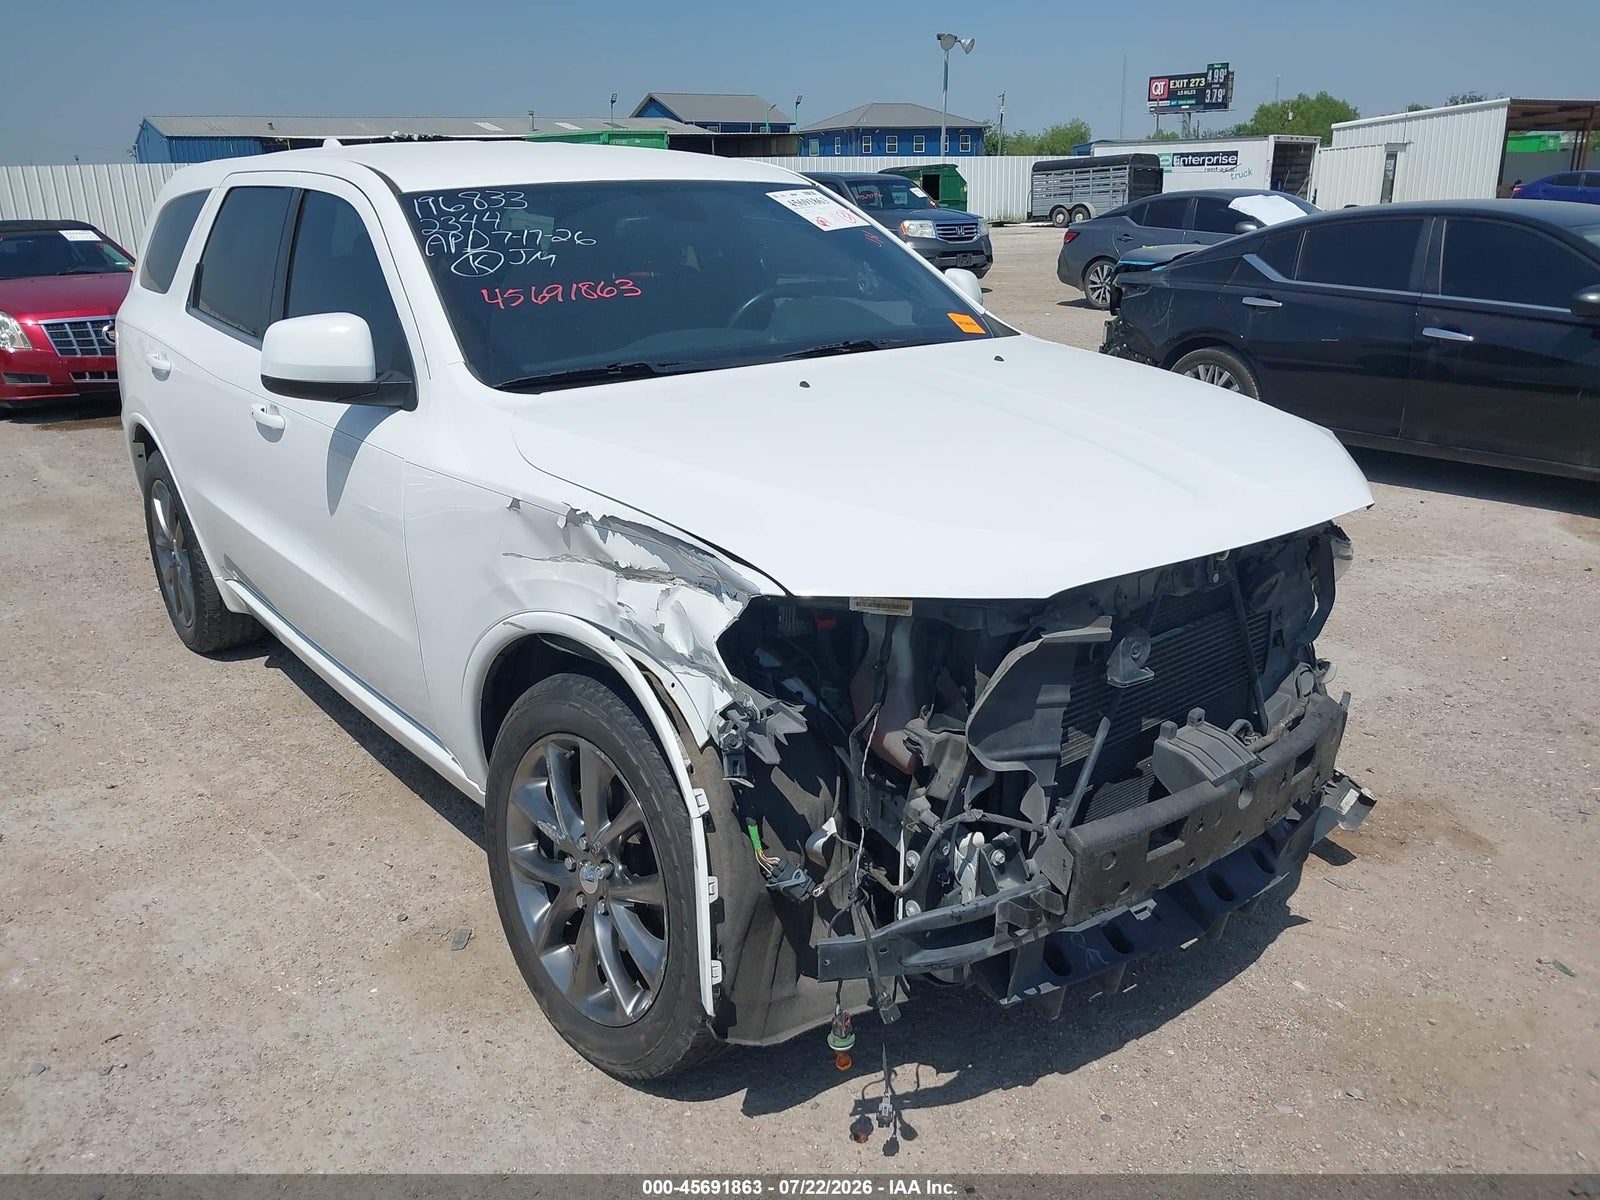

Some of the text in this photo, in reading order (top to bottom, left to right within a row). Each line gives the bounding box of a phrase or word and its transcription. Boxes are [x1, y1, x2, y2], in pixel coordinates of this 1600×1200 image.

[1152, 81, 1166, 96] QT
[1170, 77, 1206, 89] EXIT 273
[1173, 153, 1237, 167] Enterprise
[1230, 168, 1253, 181] truck
[413, 190, 528, 217] 196833
[420, 211, 501, 236] 2344
[425, 229, 597, 257] APD 7-17-26
[480, 279, 642, 310] 45691863
